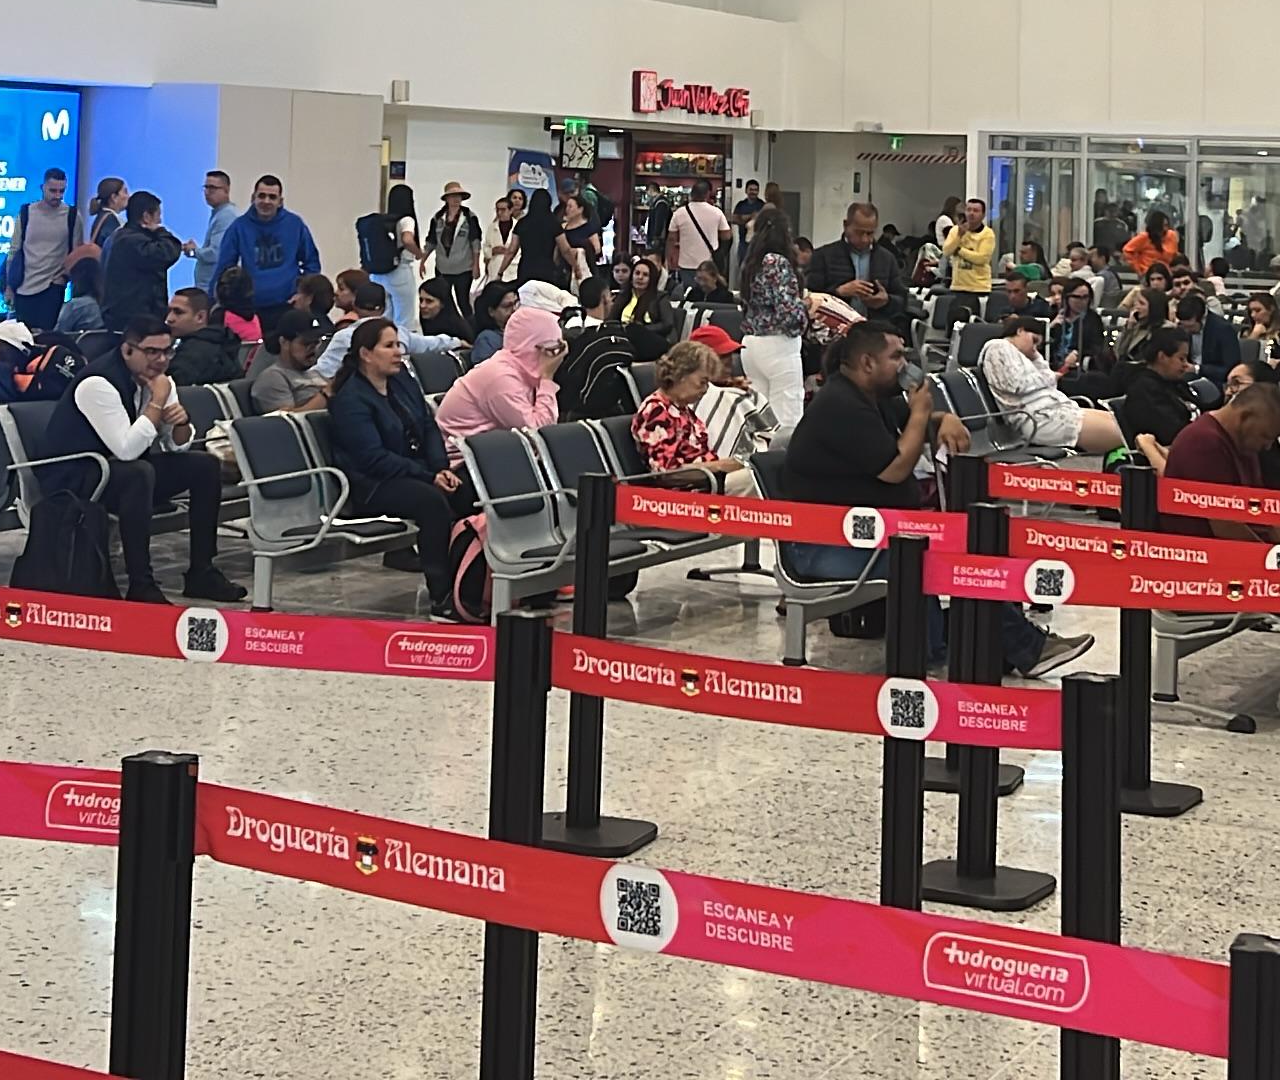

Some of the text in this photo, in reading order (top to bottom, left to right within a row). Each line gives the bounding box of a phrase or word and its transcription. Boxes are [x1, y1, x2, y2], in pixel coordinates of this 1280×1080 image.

[1173, 487, 1245, 510] Droguería
[723, 504, 793, 527] Alemana
[1129, 540, 1209, 564] Alemana
[952, 576, 1008, 589] DESCUBRE
[1130, 575, 1223, 598] Droguería
[26, 602, 113, 632] Alemana
[245, 627, 305, 641] ESCANEA Y
[245, 640, 303, 655] DESCUBRE
[410, 653, 472, 667] virtual.com
[572, 648, 803, 704] Droguería Alemana
[958, 700, 1028, 717] ESCANEA Y
[959, 716, 1028, 731] DESCUBRE
[63, 788, 121, 813] tudrog
[78, 810, 120, 826] virtua
[225, 805, 506, 892] Droguería Alemana
[703, 900, 794, 929] ESCANEA Y
[705, 921, 794, 952] DESCUBRE
[964, 971, 1065, 1003] virtual.com
